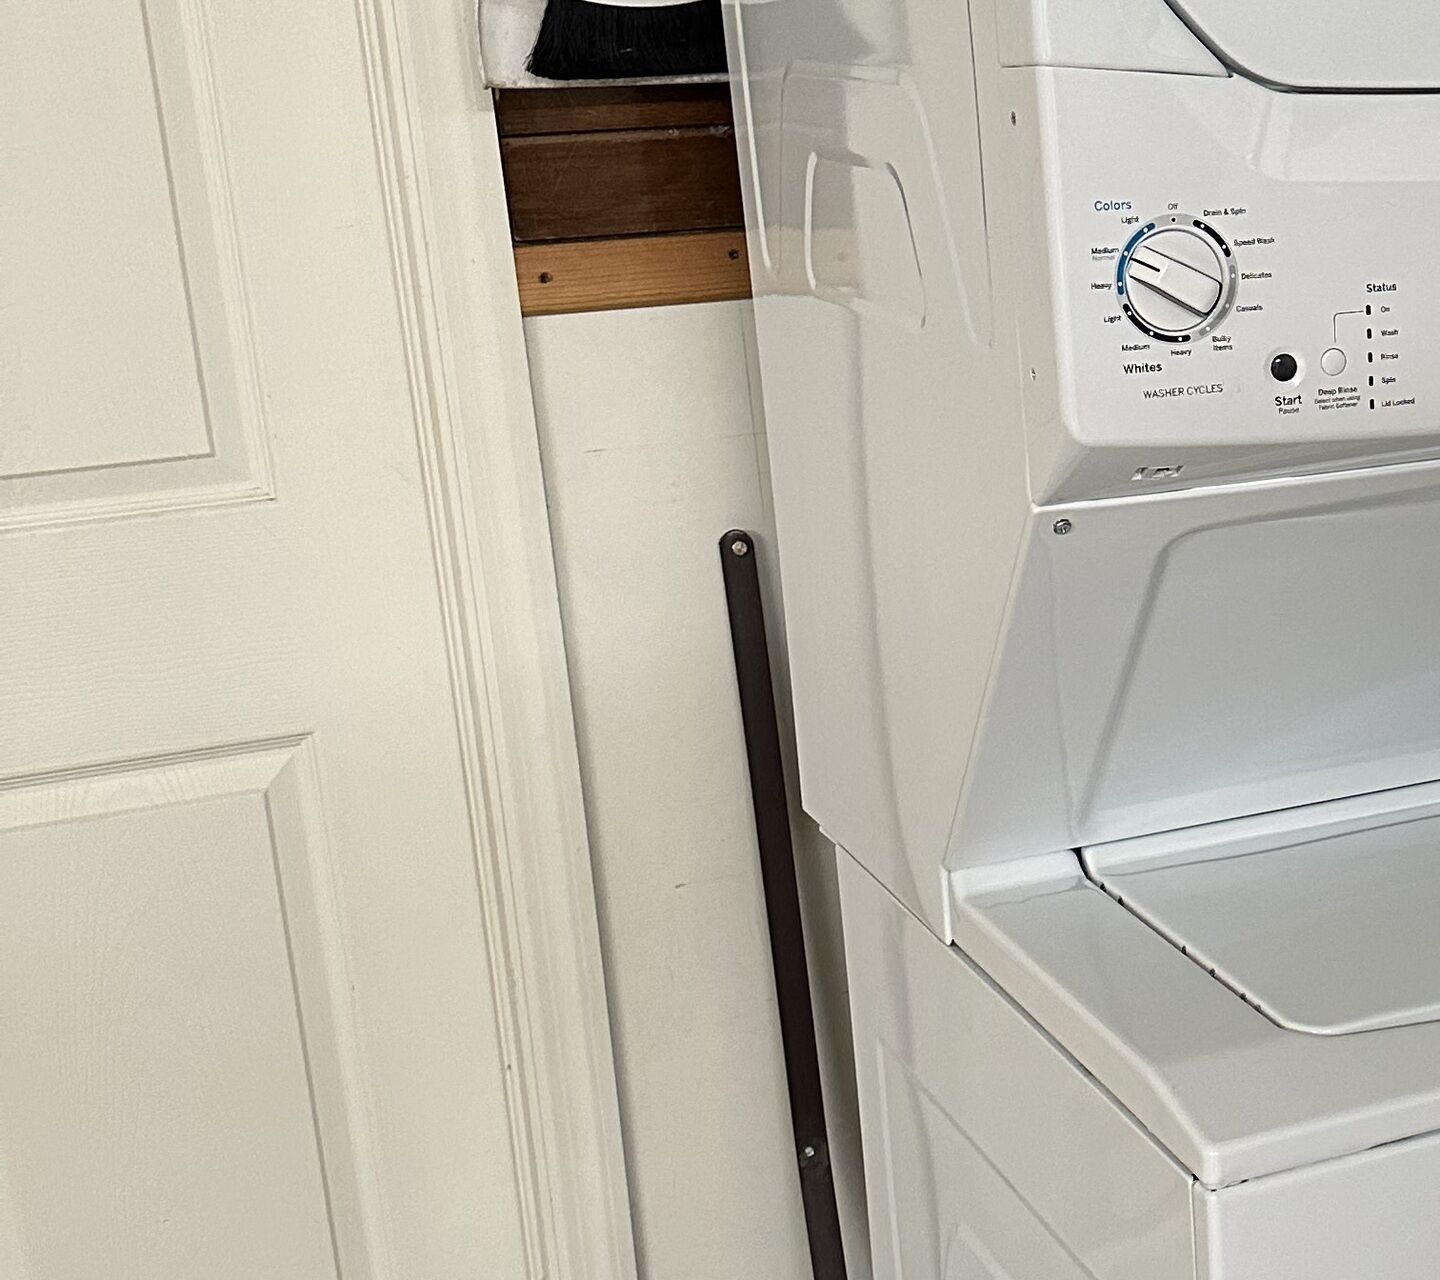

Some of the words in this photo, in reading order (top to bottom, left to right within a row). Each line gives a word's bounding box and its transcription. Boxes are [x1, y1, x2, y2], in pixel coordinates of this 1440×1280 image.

[1094, 200, 1132, 212] Colors
[1203, 209, 1222, 217] Drain
[1224, 208, 1229, 216] &
[1230, 207, 1246, 216] Spin
[1121, 216, 1139, 225] Light
[1234, 238, 1256, 248] Speed
[1091, 246, 1119, 255] Medium
[1241, 272, 1272, 280] Delicates
[1091, 283, 1112, 291] Heavy
[1366, 283, 1397, 293] Status
[1103, 315, 1121, 324] Light
[1381, 329, 1399, 337] Wash
[1212, 336, 1231, 344] Bulky
[1121, 343, 1150, 352] Medium
[1170, 349, 1192, 357] Heavy
[1123, 362, 1162, 374] Whites
[1143, 386, 1184, 399] WASHER
[1186, 383, 1223, 396] CYCLES
[1318, 388, 1337, 396] Deep
[1338, 386, 1358, 394] Rinse
[1274, 394, 1303, 406] Start
[1393, 397, 1415, 406] Locked
